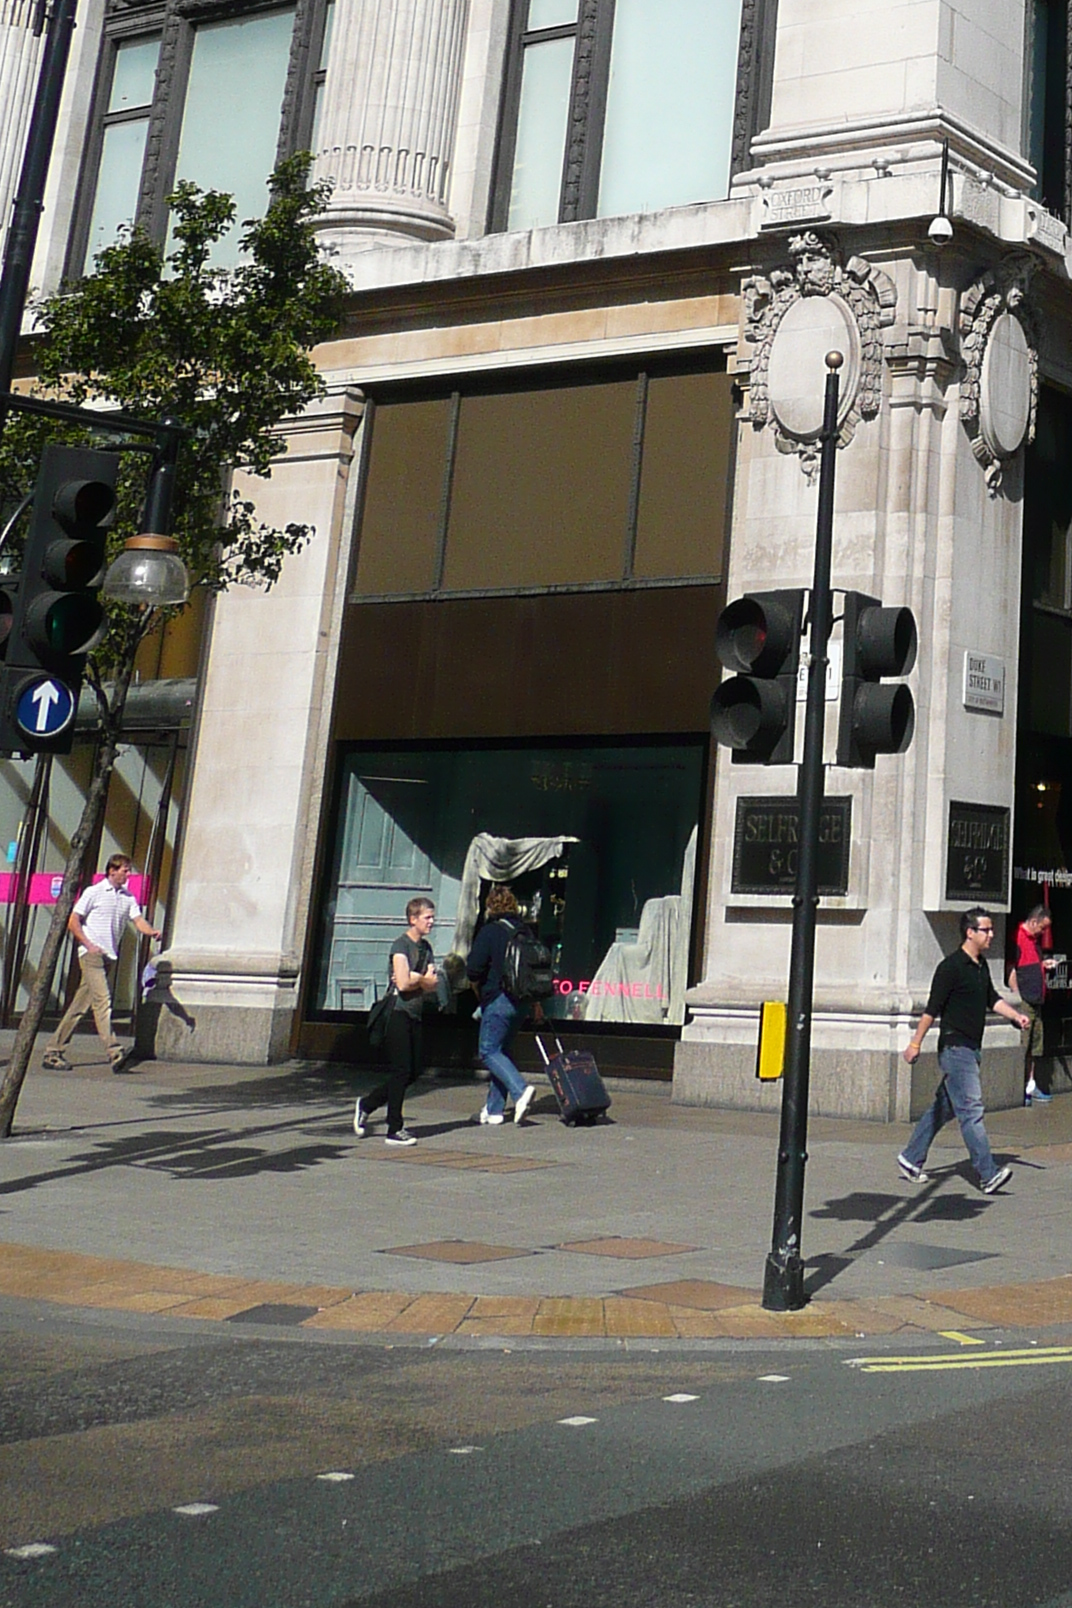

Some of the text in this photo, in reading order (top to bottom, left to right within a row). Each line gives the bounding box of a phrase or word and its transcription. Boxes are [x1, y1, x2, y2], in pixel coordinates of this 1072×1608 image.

[771, 186, 821, 207] OXFORD
[770, 204, 817, 221] STREET
[969, 657, 986, 673] DUKE
[969, 674, 991, 691] STREET
[745, 814, 842, 843] SELFRGE
[579, 980, 667, 1000] FENNELL
